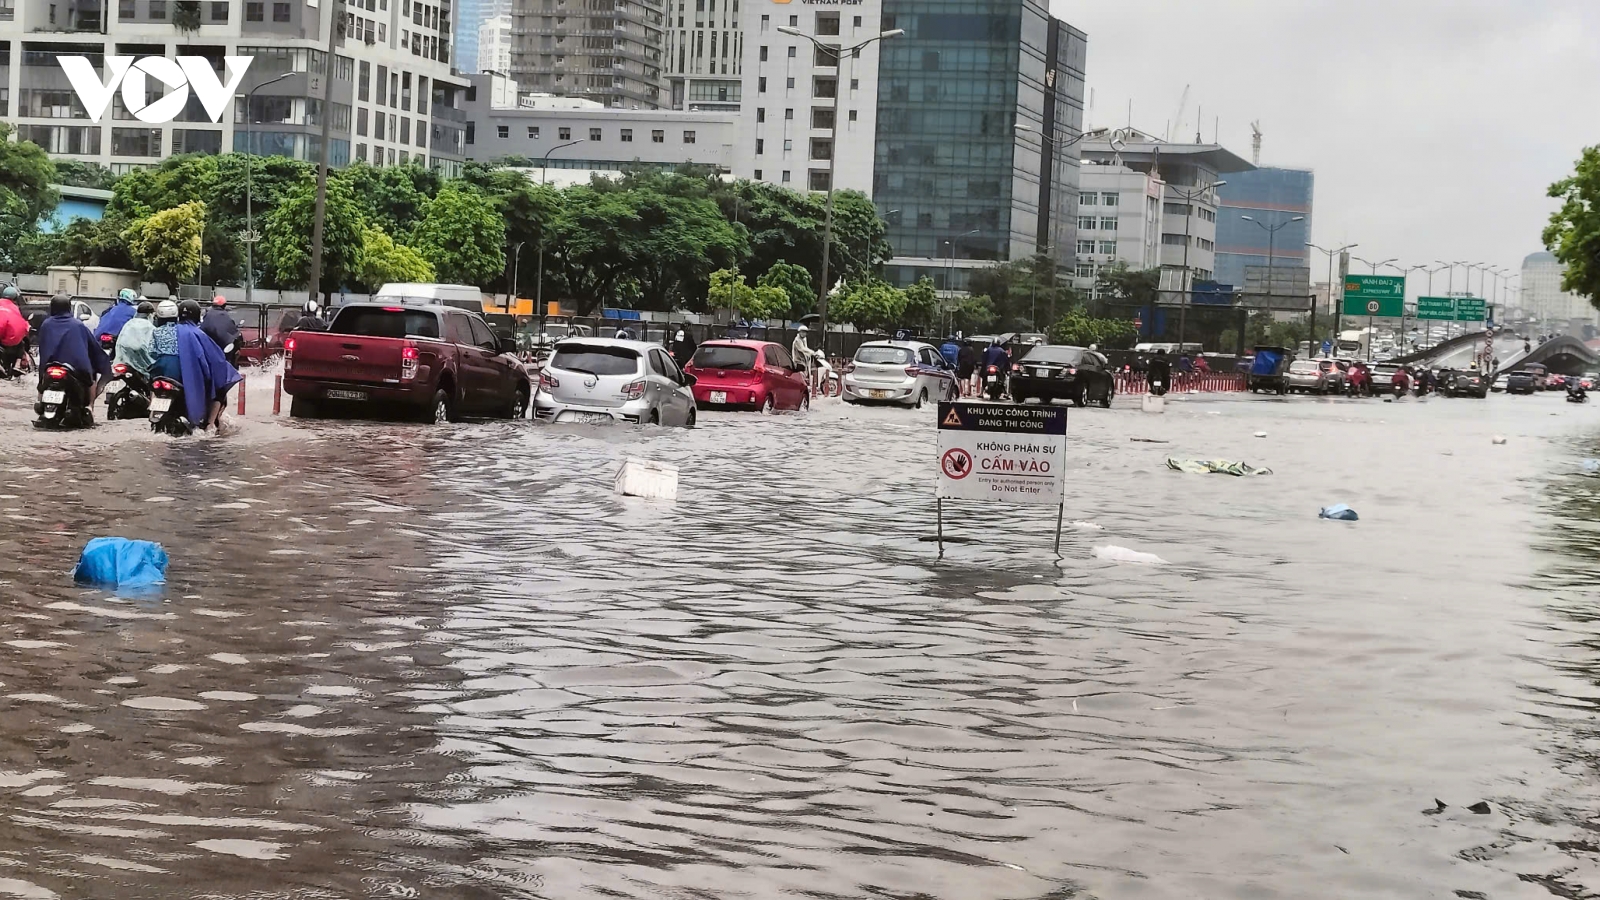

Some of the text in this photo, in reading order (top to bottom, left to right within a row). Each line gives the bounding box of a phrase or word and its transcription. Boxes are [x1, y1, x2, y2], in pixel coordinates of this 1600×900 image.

[986, 408, 1003, 416] VỰC
[1005, 408, 1029, 417] CÔNG
[1031, 409, 1056, 418] TRÌNH
[978, 419, 1002, 427] ĐANG
[1020, 420, 1044, 428] CÔNG
[976, 441, 1056, 455] KHÔNG PHẬN SỰ
[981, 454, 1050, 473] CẤM VÀO
[992, 484, 1002, 492] Do
[1020, 486, 1040, 494] Enter
